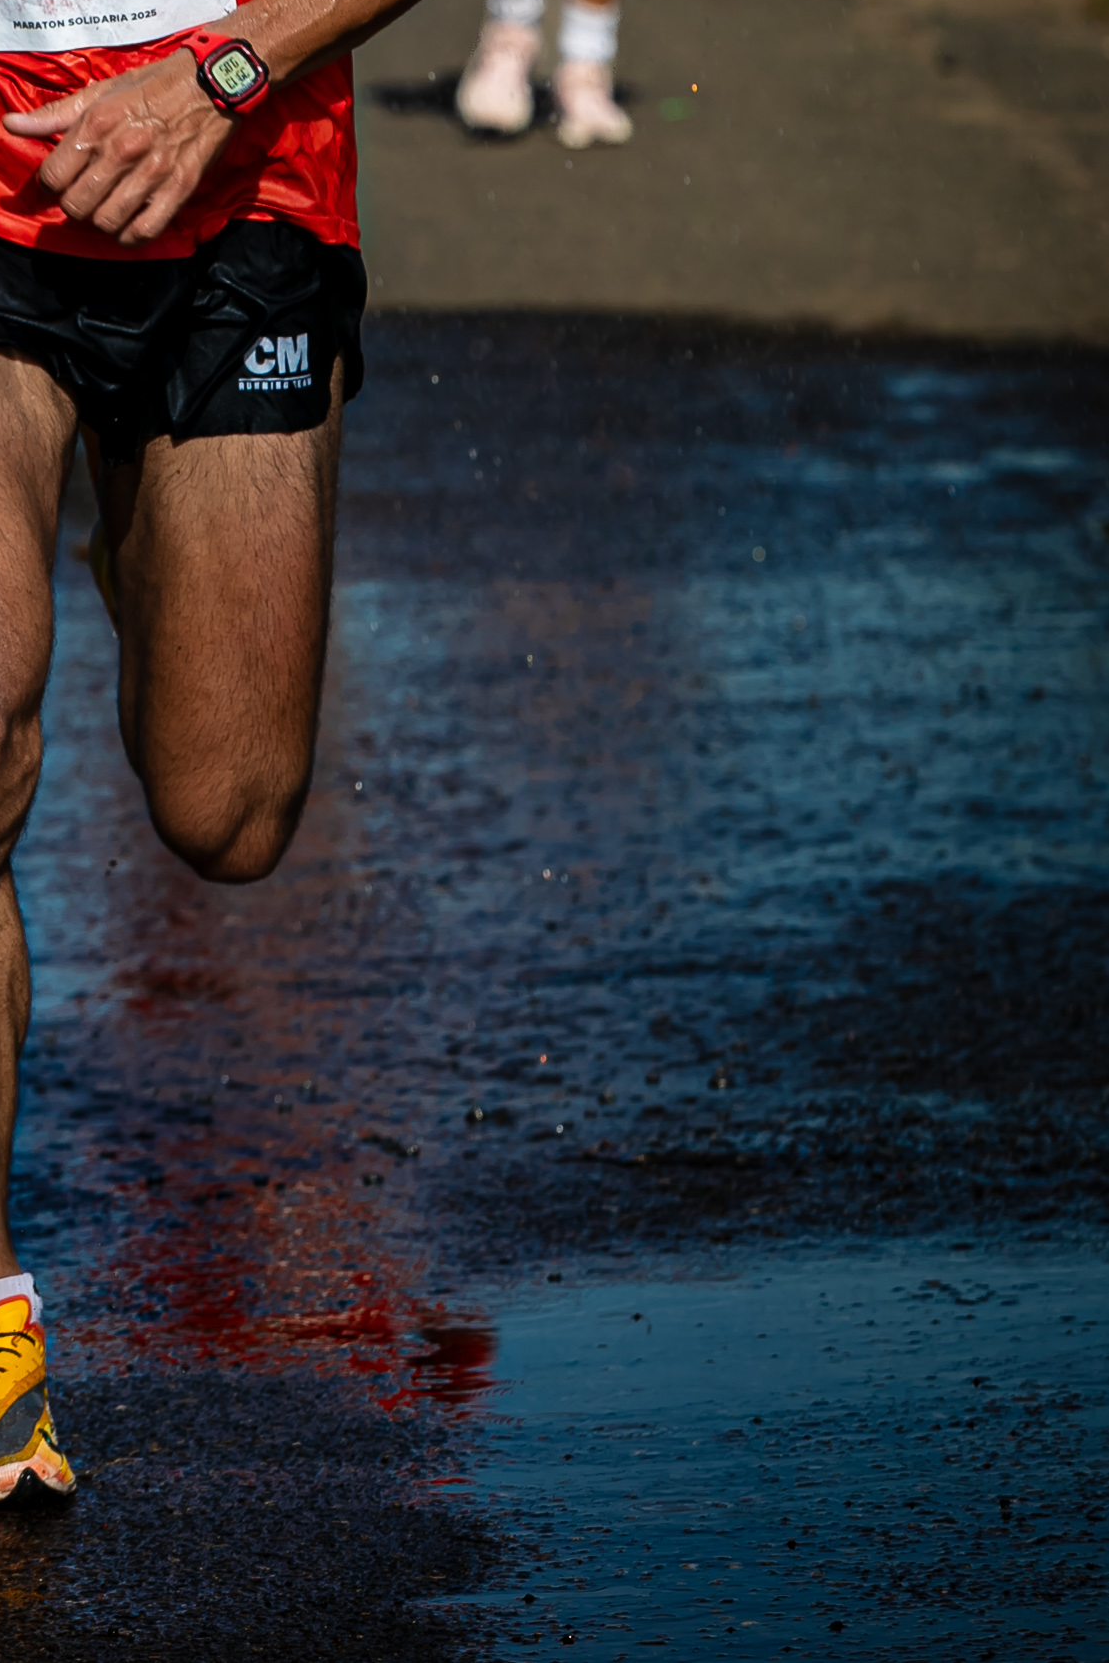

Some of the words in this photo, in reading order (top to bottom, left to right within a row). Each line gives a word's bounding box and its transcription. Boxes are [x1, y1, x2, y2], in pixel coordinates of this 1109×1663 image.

[13, 20, 65, 30] MARATON
[68, 14, 128, 26] SOLIDARIA
[131, 8, 157, 21] 2025
[244, 333, 309, 375] CM
[238, 381, 289, 391] RUNNING
[292, 377, 312, 388] TEAM
